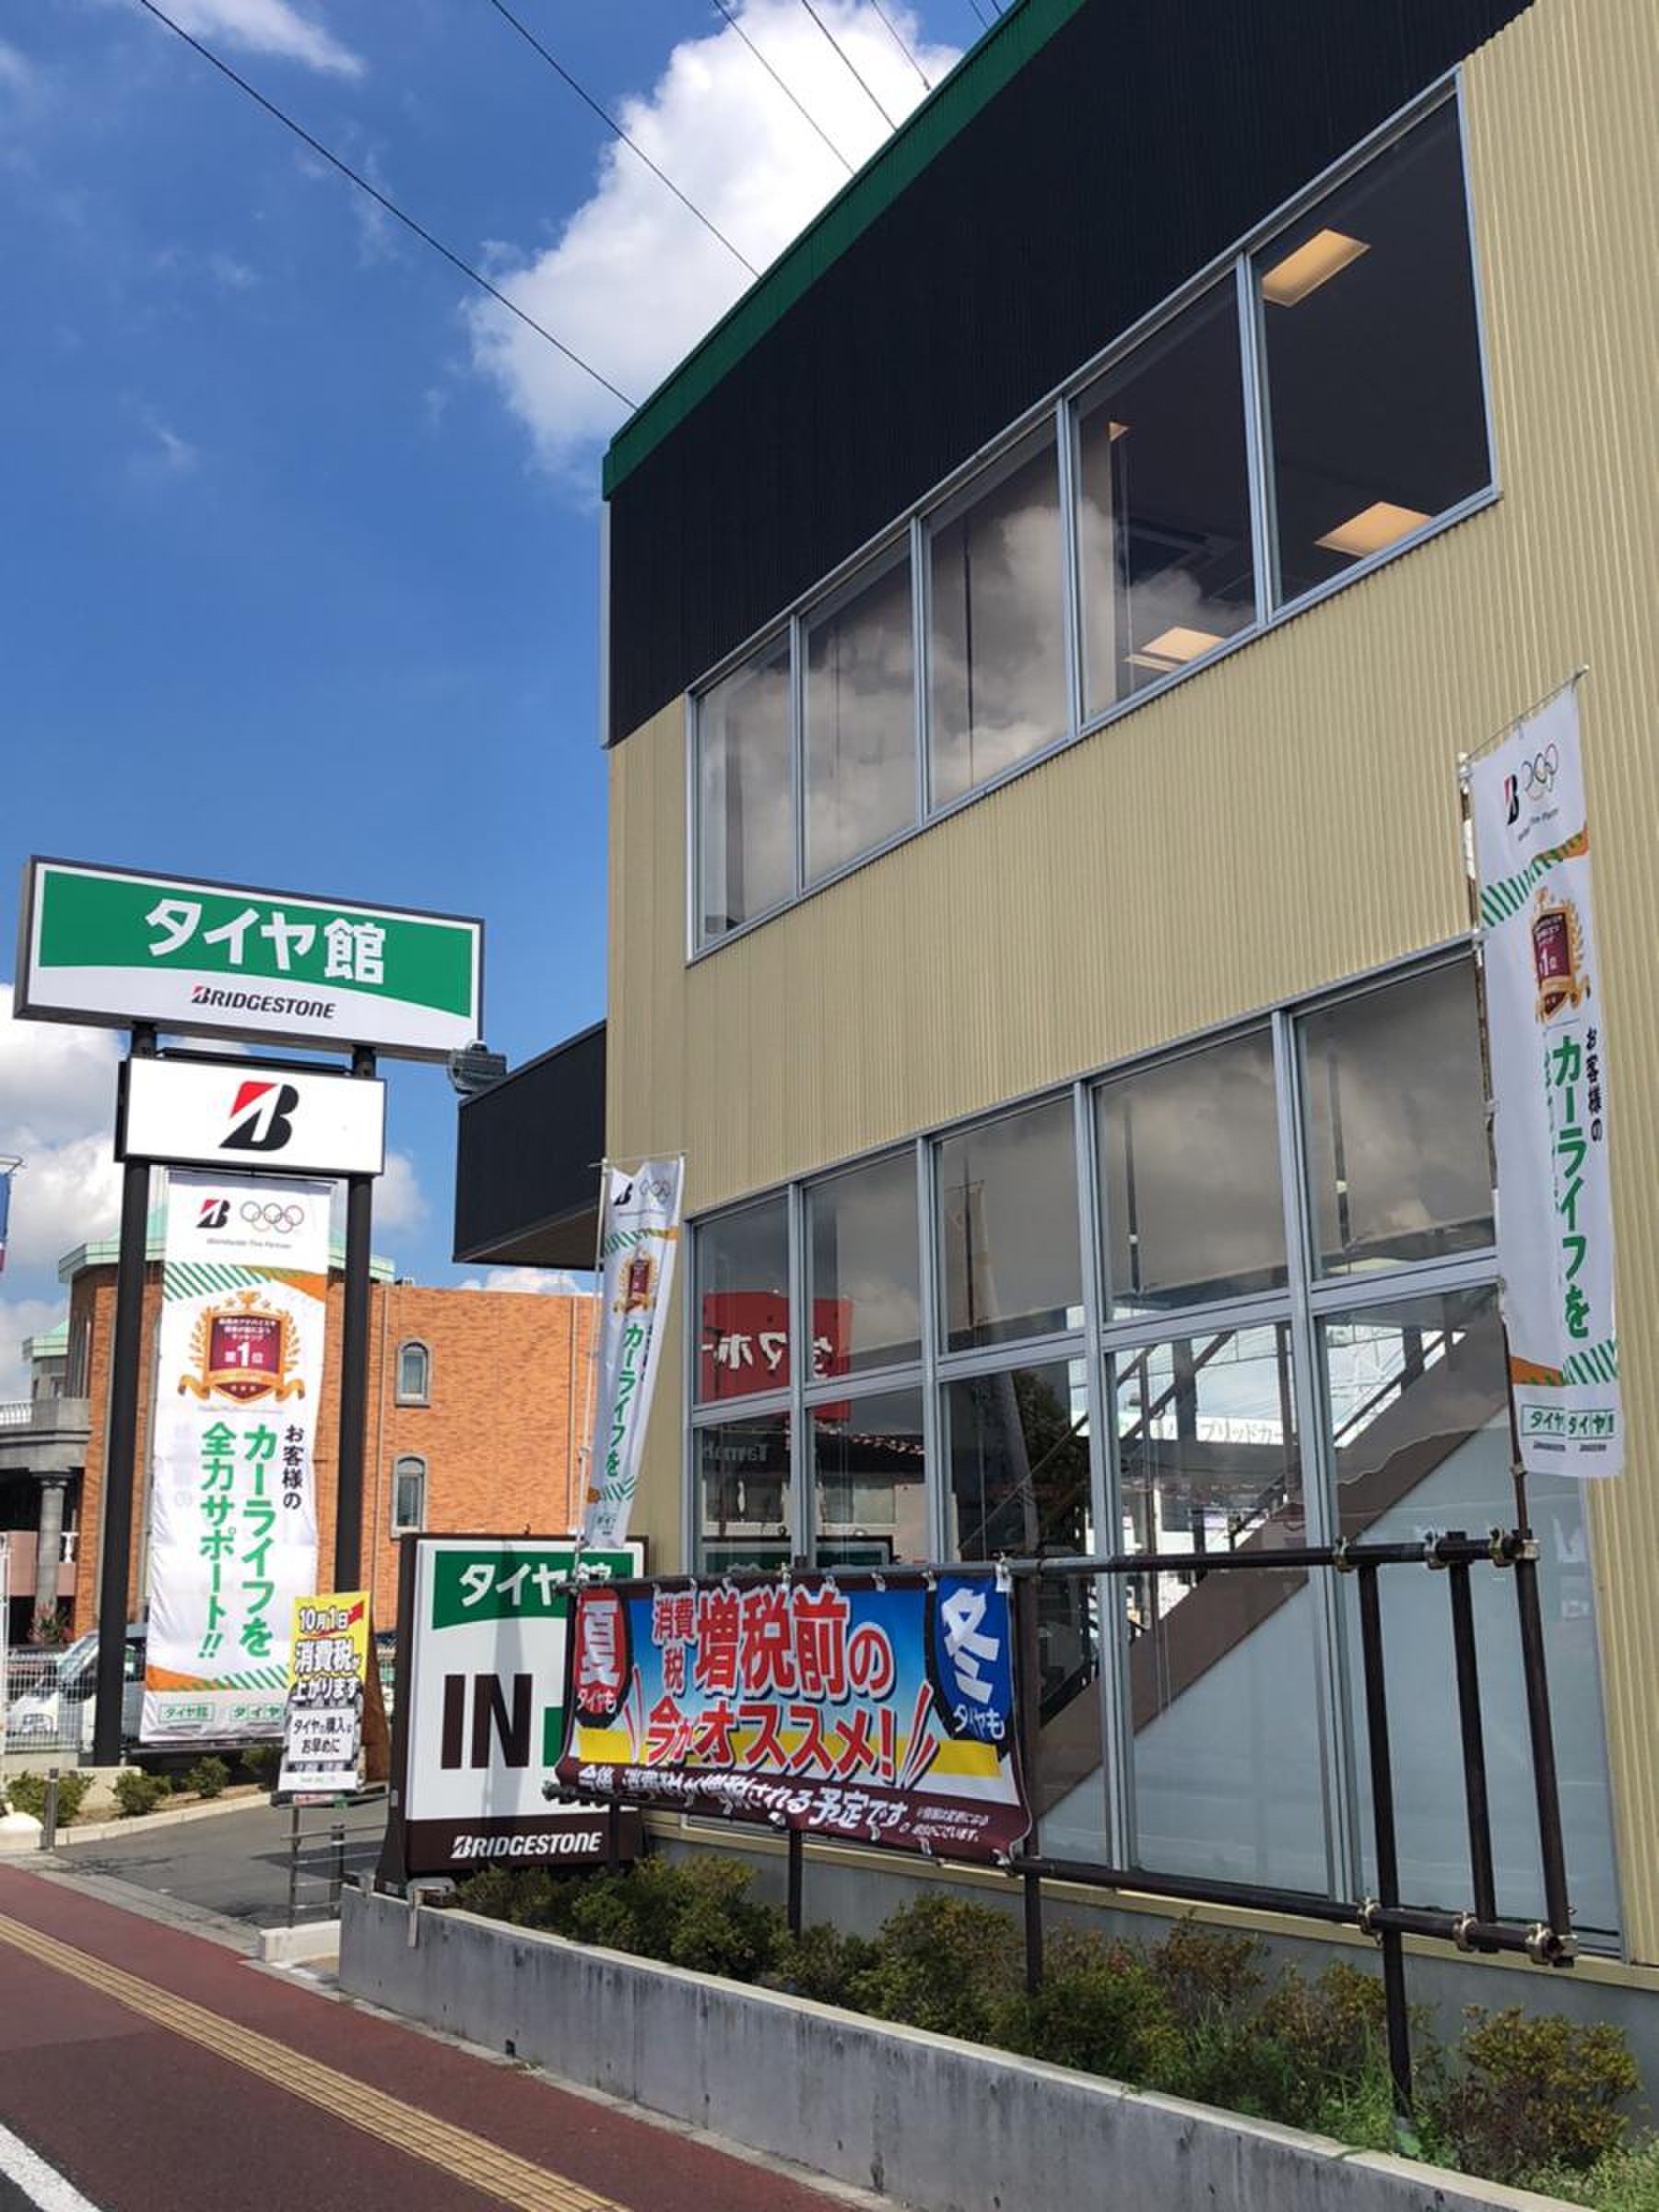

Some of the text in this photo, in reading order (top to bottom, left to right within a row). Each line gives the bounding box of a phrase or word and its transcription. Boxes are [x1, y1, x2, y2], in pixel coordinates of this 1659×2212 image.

[145, 899, 387, 984] タイヤ館
[191, 985, 336, 1019] BRIDGESTONE
[1550, 1035, 1590, 1339] カーライフを
[606, 1324, 644, 1477] カーライフを
[282, 1424, 305, 1511] お客様の
[240, 1423, 276, 1658] カーライフを
[299, 1606, 350, 1635] 10月1日
[579, 1598, 621, 1687] 夏
[695, 1587, 896, 1700] 増税前の
[940, 1585, 1002, 1705] 冬
[234, 1705, 287, 1719] タイヤ
[441, 1673, 533, 1770] IN
[450, 1832, 603, 1859] BRIDGESTONE
